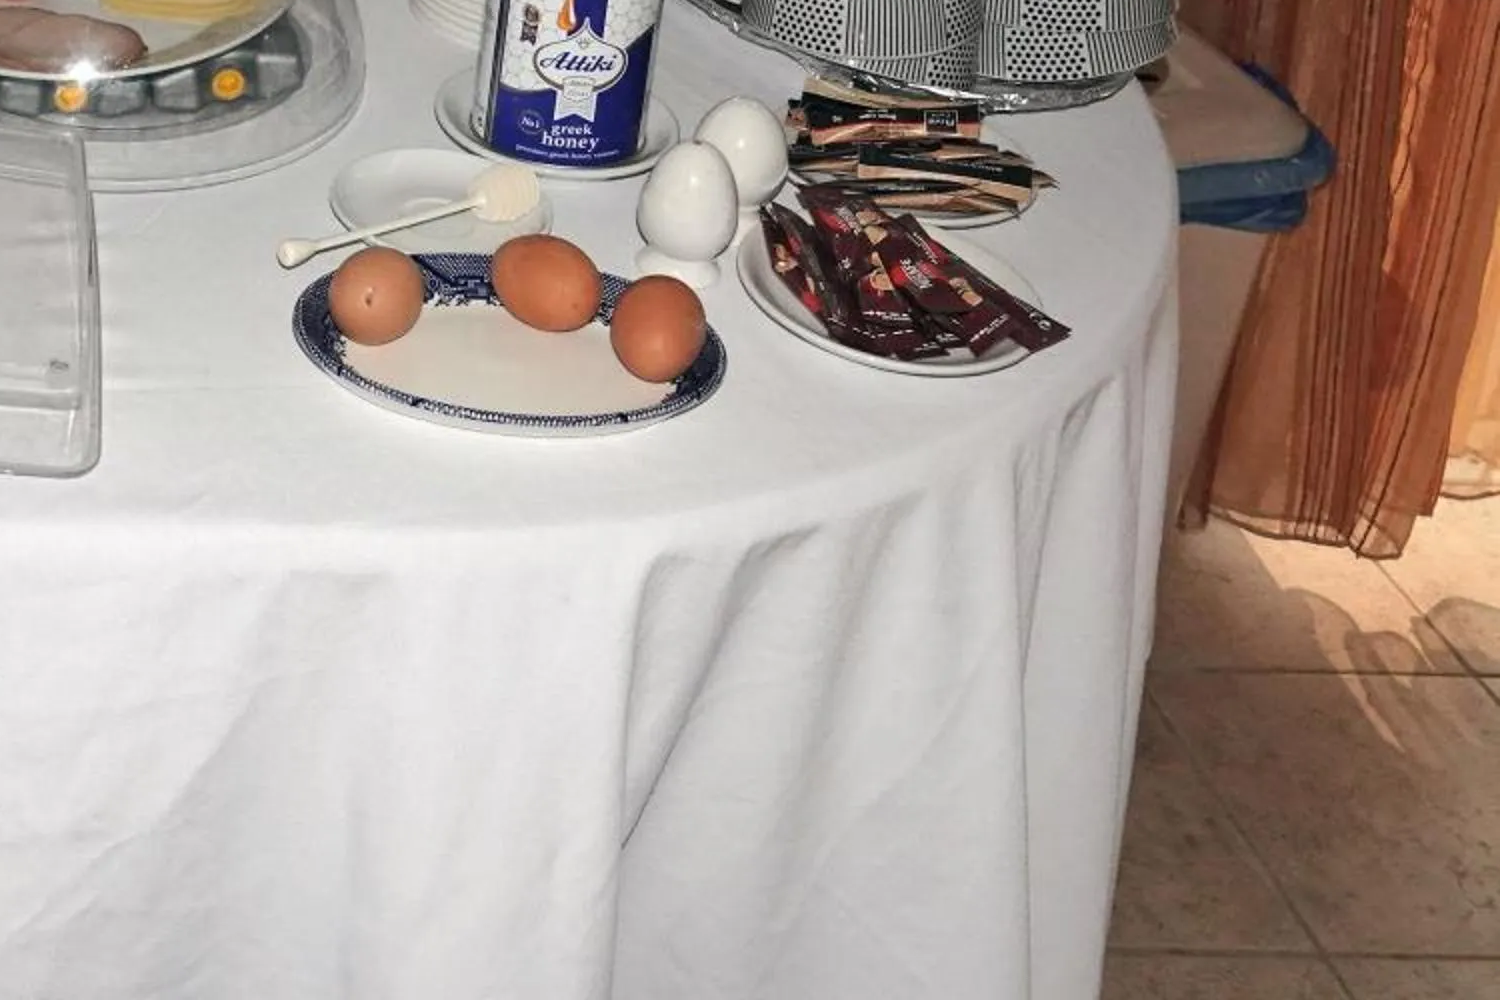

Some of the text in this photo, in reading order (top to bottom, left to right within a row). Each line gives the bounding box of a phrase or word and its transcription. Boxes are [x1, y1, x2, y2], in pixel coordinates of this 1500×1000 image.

[539, 51, 618, 73] Attiki
[551, 123, 593, 137] greek
[541, 130, 600, 153] honey
